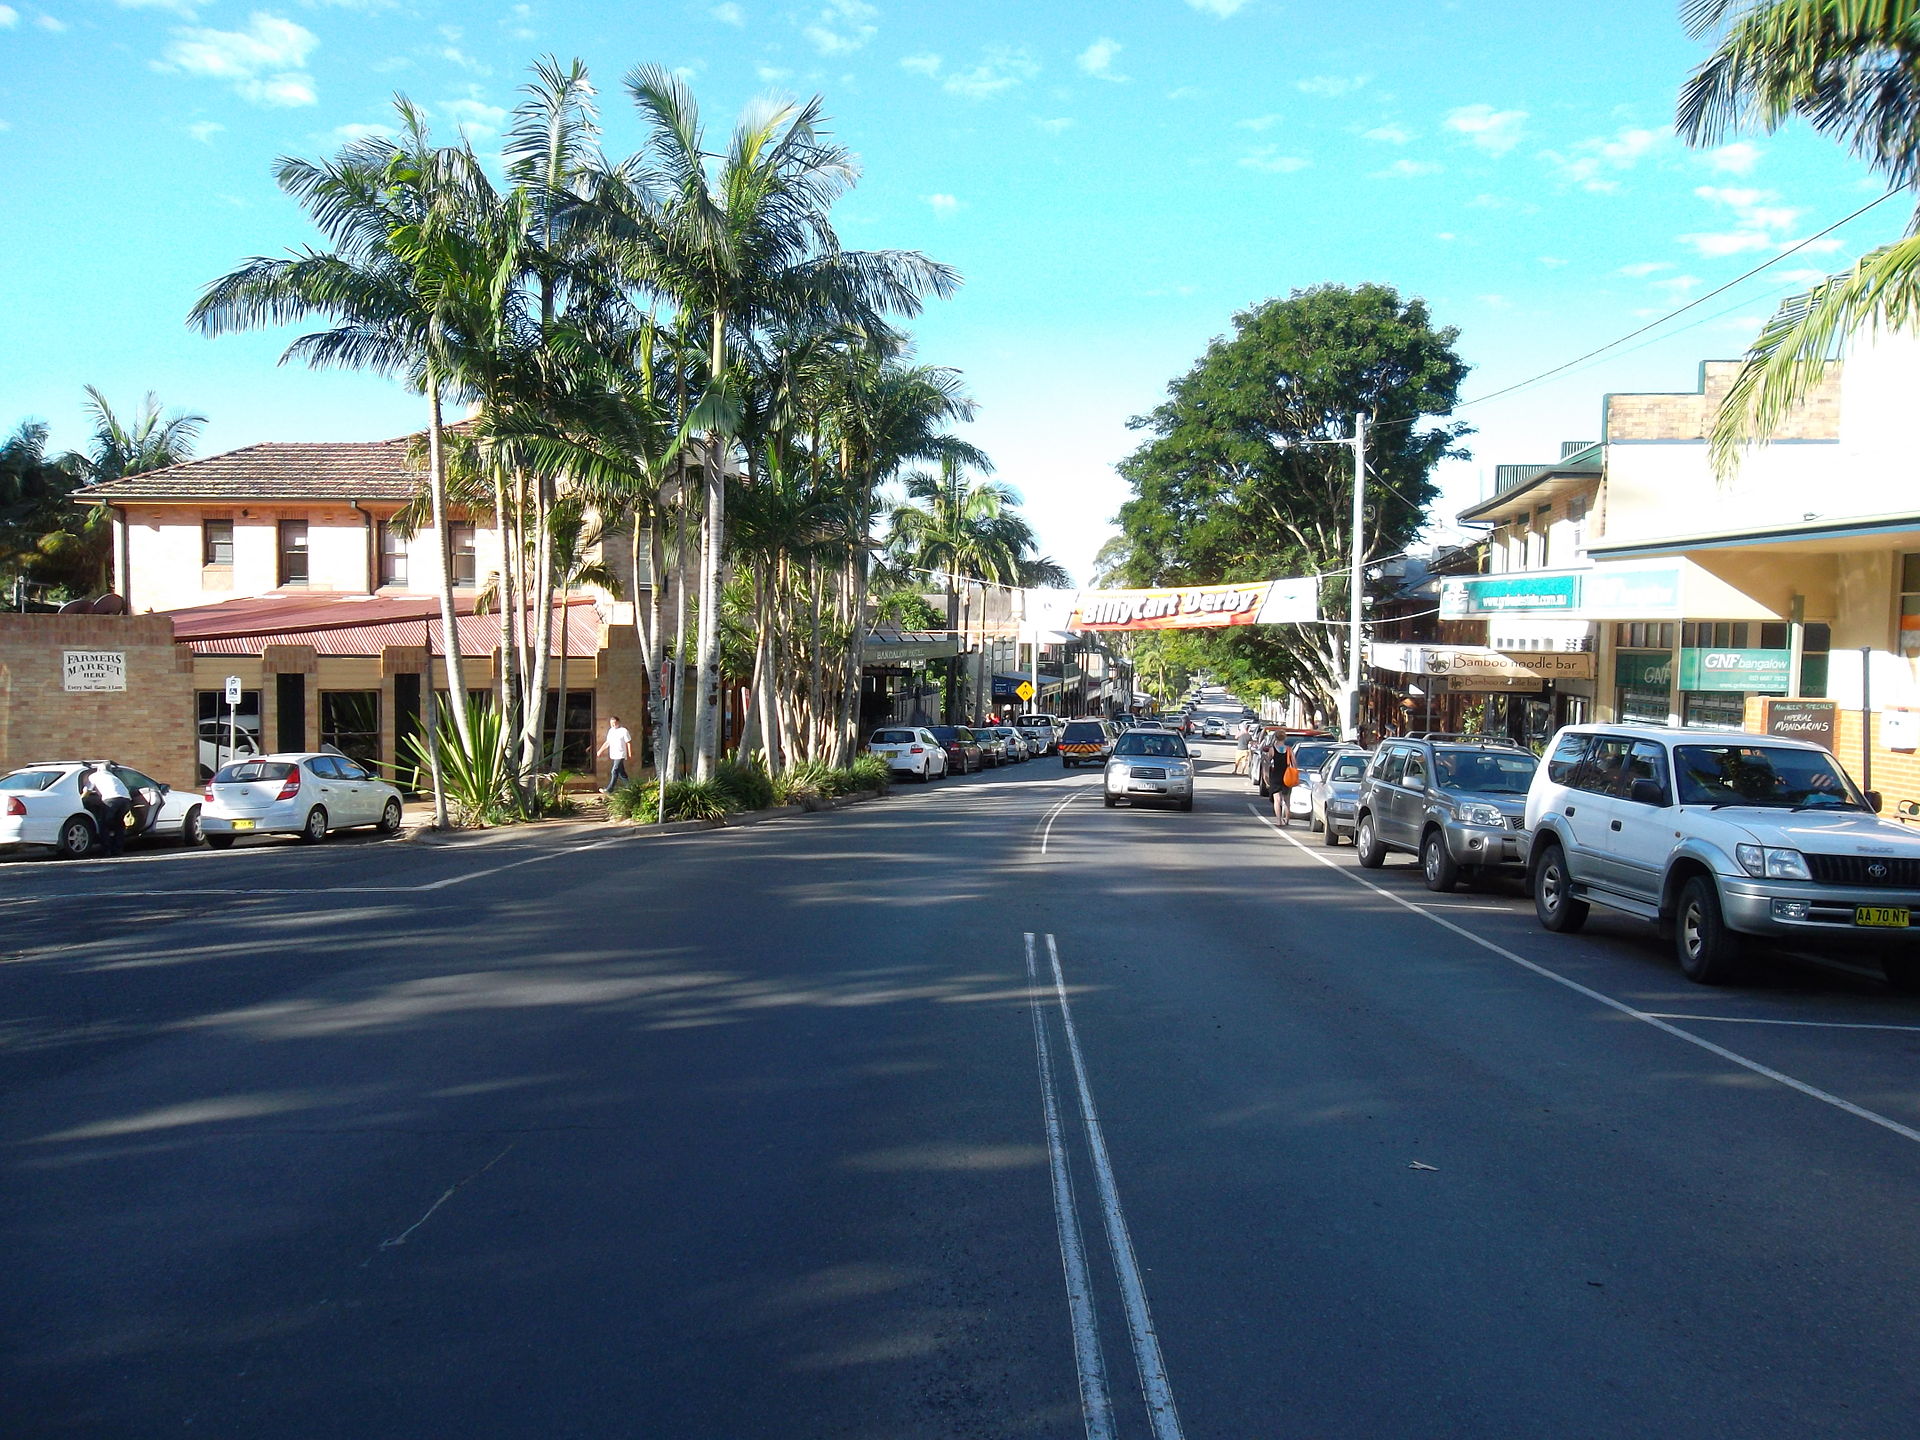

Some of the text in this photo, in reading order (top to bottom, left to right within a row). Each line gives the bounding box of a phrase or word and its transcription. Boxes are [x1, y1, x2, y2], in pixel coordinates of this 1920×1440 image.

[1183, 590, 1257, 614] Derby
[67, 655, 121, 664] FARMERS
[1453, 655, 1577, 669] Bamboo noodle bar
[1705, 653, 1787, 670] GNF bangalow
[68, 663, 121, 677] MARKET
[1465, 676, 1498, 687] Bamboo
[1775, 722, 1829, 731] MANDARINS
[1858, 909, 1908, 922] AA 70 NT
